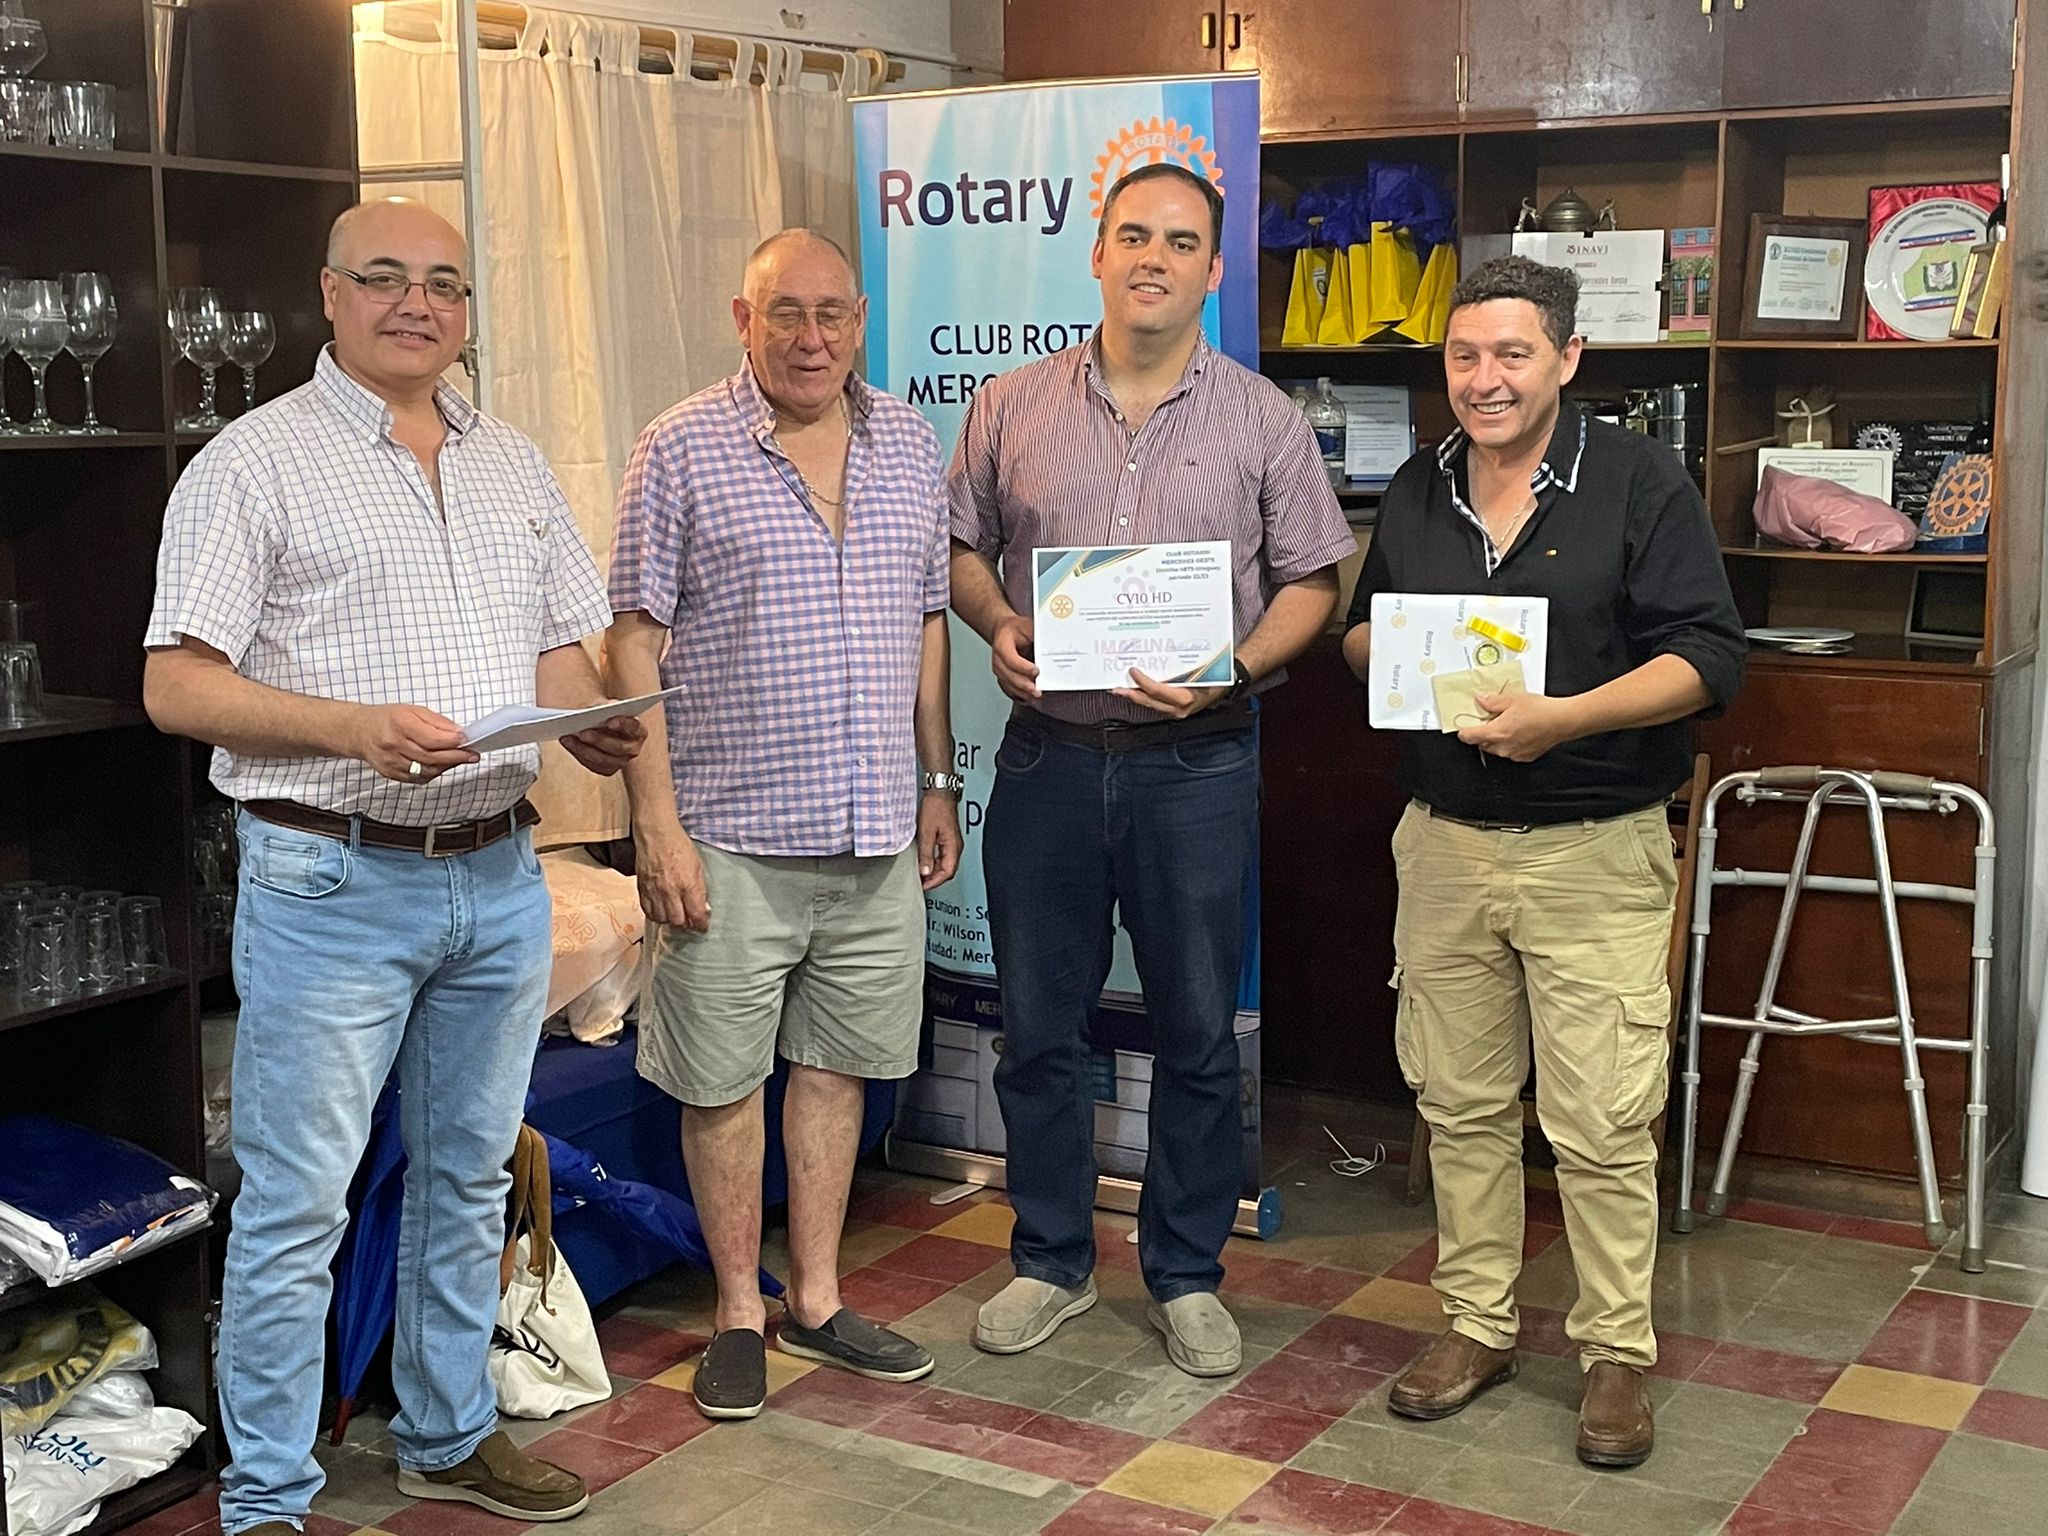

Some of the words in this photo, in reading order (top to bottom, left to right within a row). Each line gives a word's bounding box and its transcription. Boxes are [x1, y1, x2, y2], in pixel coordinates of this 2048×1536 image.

[879, 169, 1073, 235] Rotary
[930, 324, 1012, 355] CLUB
[1116, 592, 1148, 604] CV10
[1152, 592, 1172, 604] HD
[1423, 630, 1433, 657] Rotary
[1391, 664, 1401, 691] Rotary
[943, 920, 985, 942] Wilson
